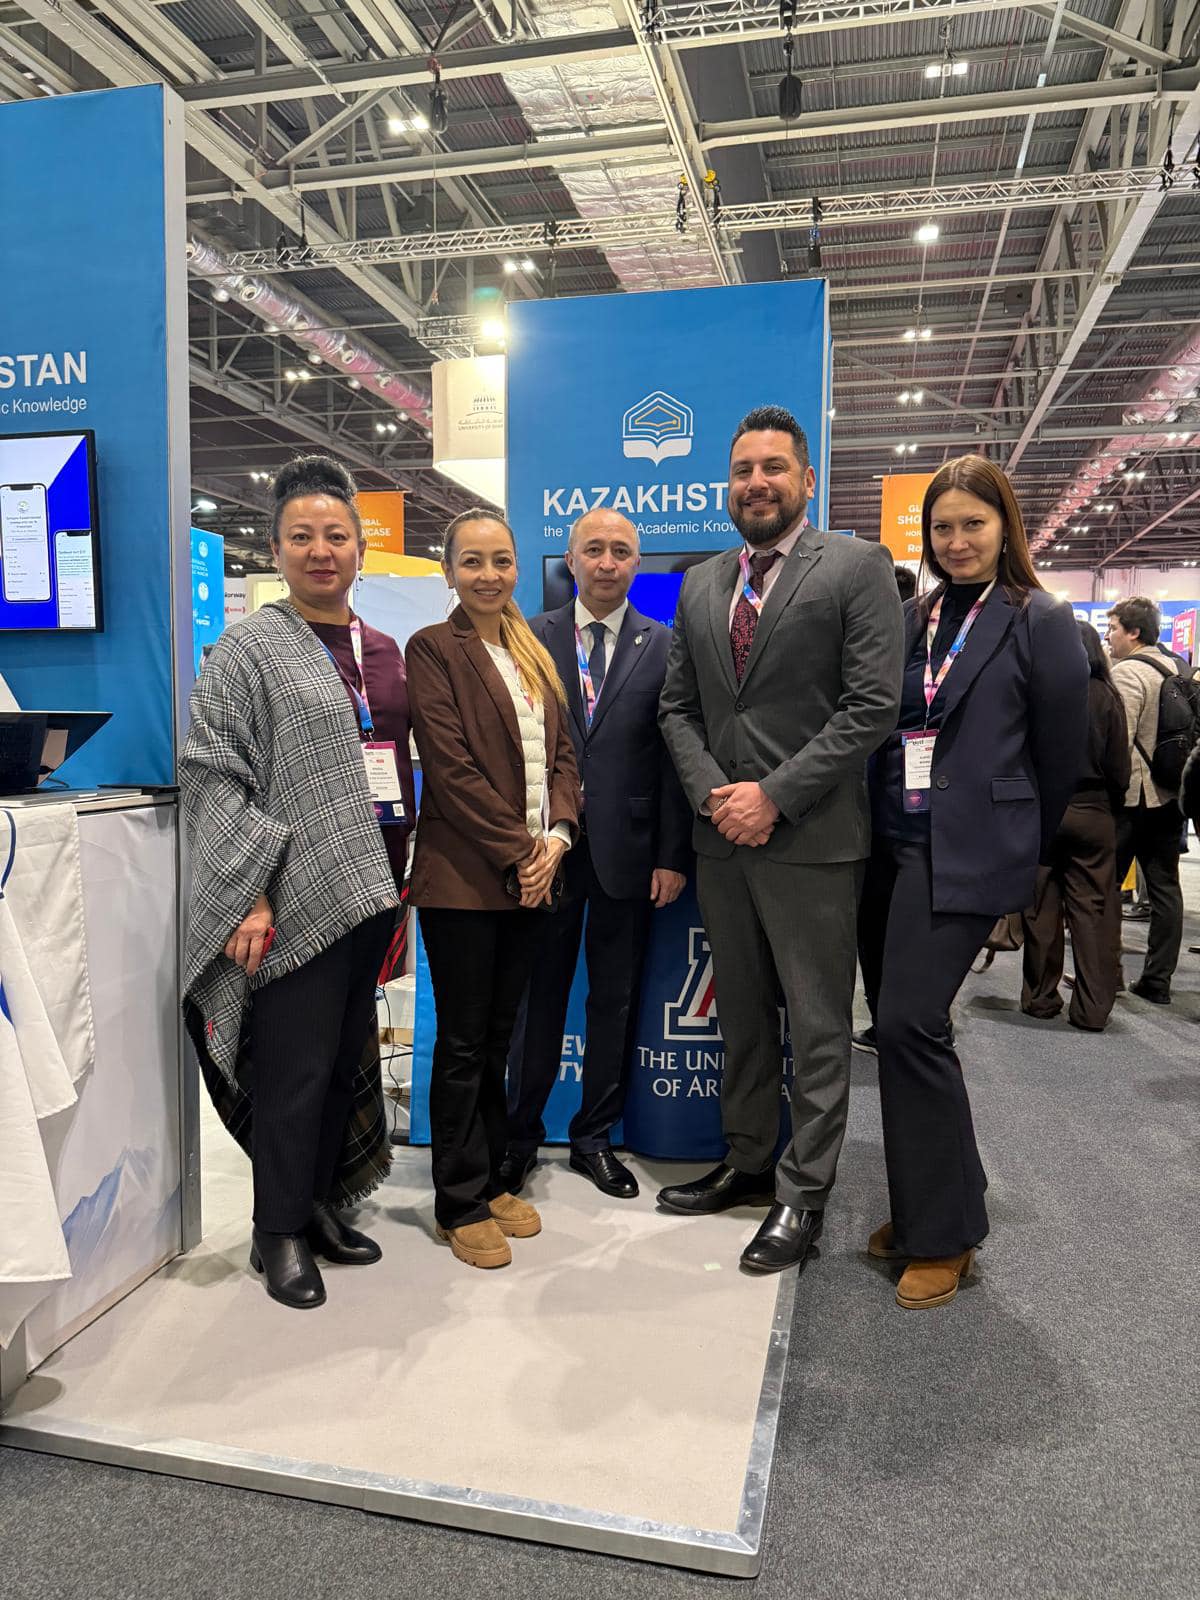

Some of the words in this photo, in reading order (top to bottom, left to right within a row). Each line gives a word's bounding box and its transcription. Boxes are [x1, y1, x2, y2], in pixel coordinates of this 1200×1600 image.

[13, 396, 87, 414] Knowledge
[544, 525, 563, 537] the
[637, 518, 700, 535] Academic
[638, 1046, 678, 1070] THE
[652, 1078, 682, 1098] OF
